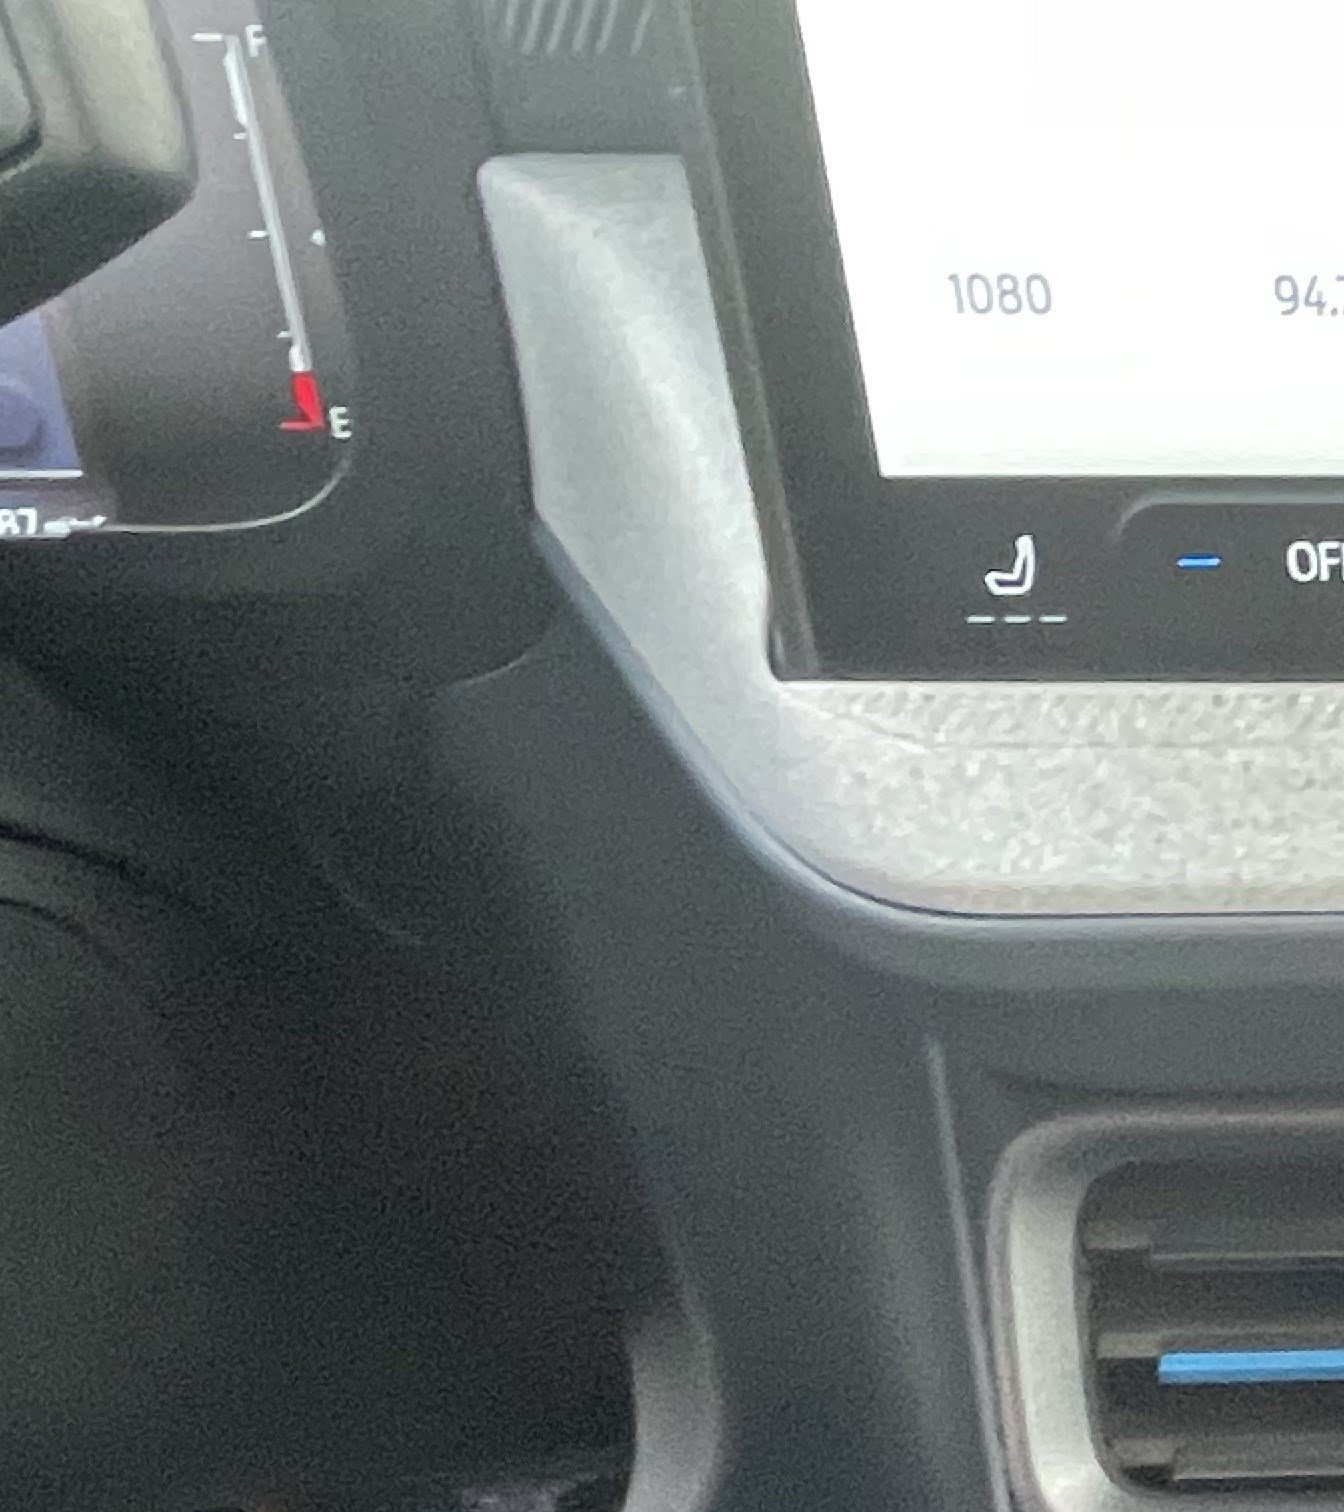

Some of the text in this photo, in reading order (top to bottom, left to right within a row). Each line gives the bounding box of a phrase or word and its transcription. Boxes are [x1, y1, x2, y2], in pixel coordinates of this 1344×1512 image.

[245, 24, 267, 58] F
[947, 272, 1052, 316] 1080
[328, 405, 353, 439] E
